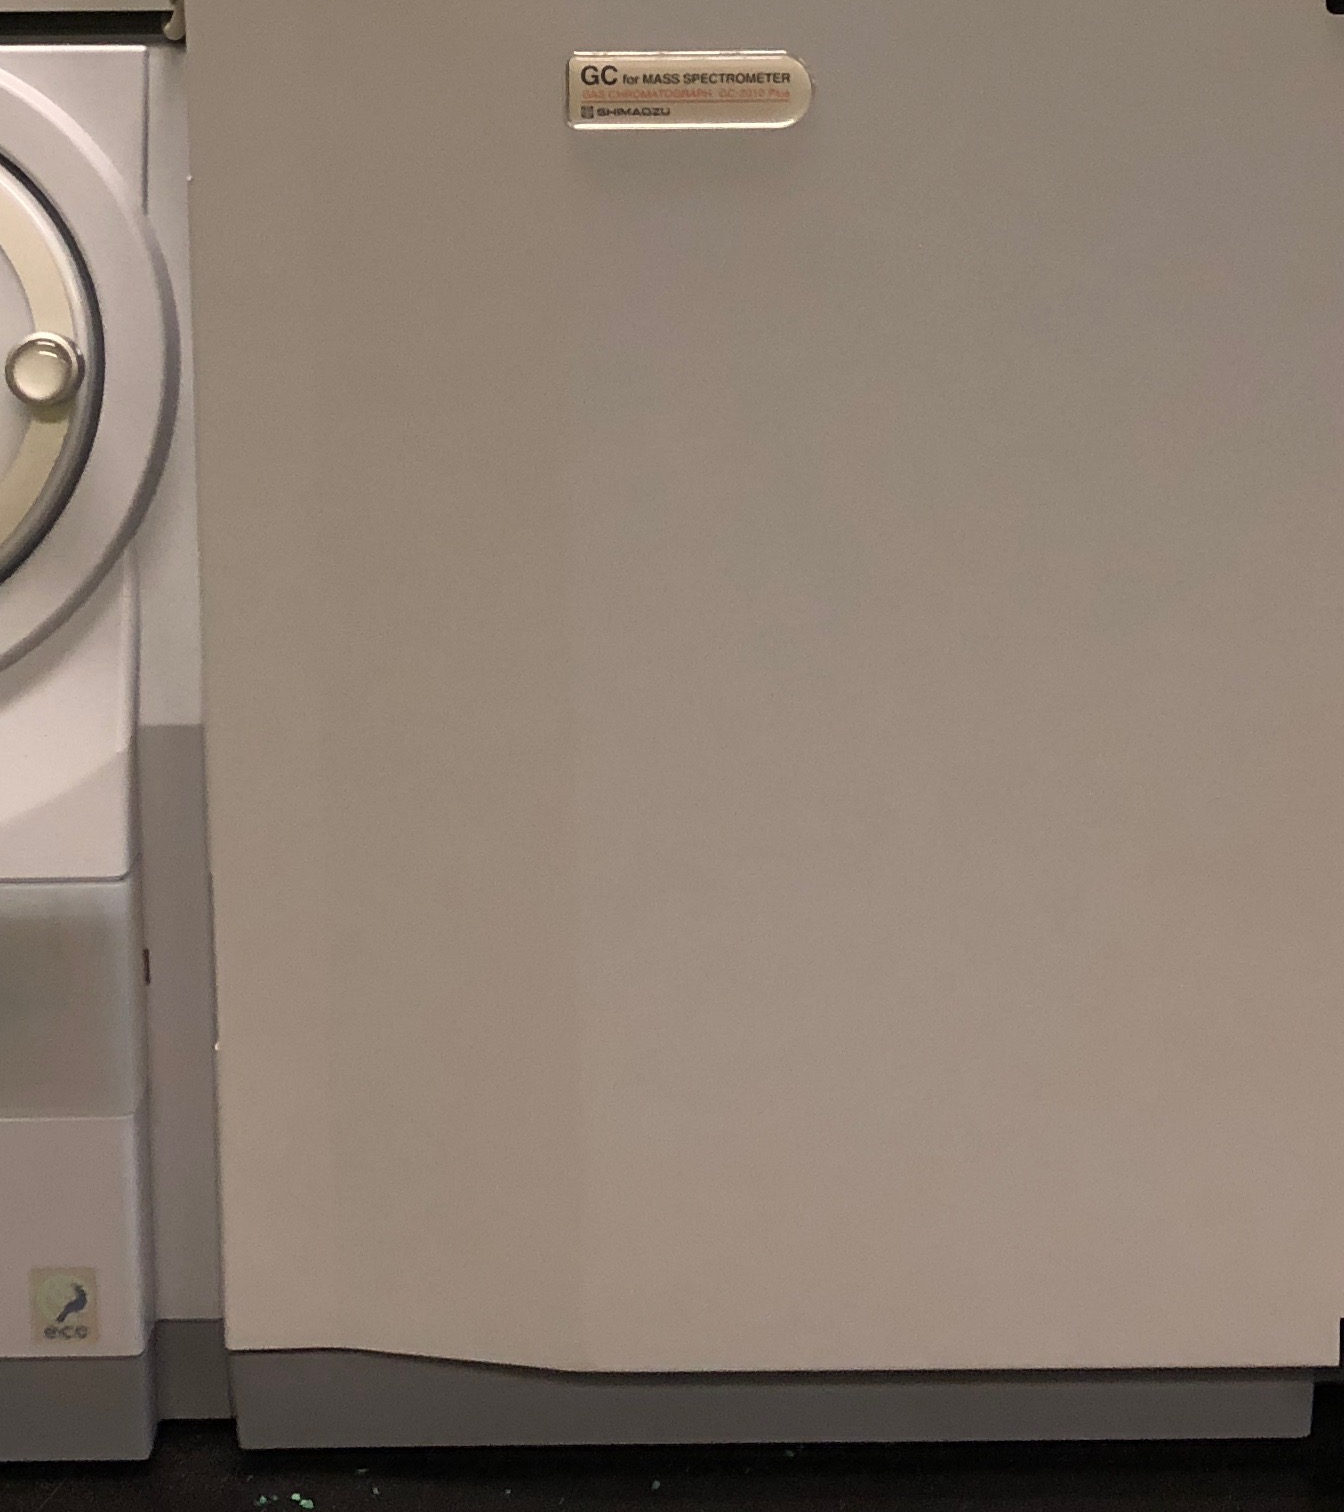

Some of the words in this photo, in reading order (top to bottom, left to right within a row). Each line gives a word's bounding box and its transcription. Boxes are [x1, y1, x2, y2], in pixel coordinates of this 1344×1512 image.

[580, 64, 618, 86] GC
[622, 73, 640, 85] for
[642, 73, 681, 85] MASS
[683, 72, 791, 85] SPECTROMETER
[597, 106, 671, 117] SHIMADZU
